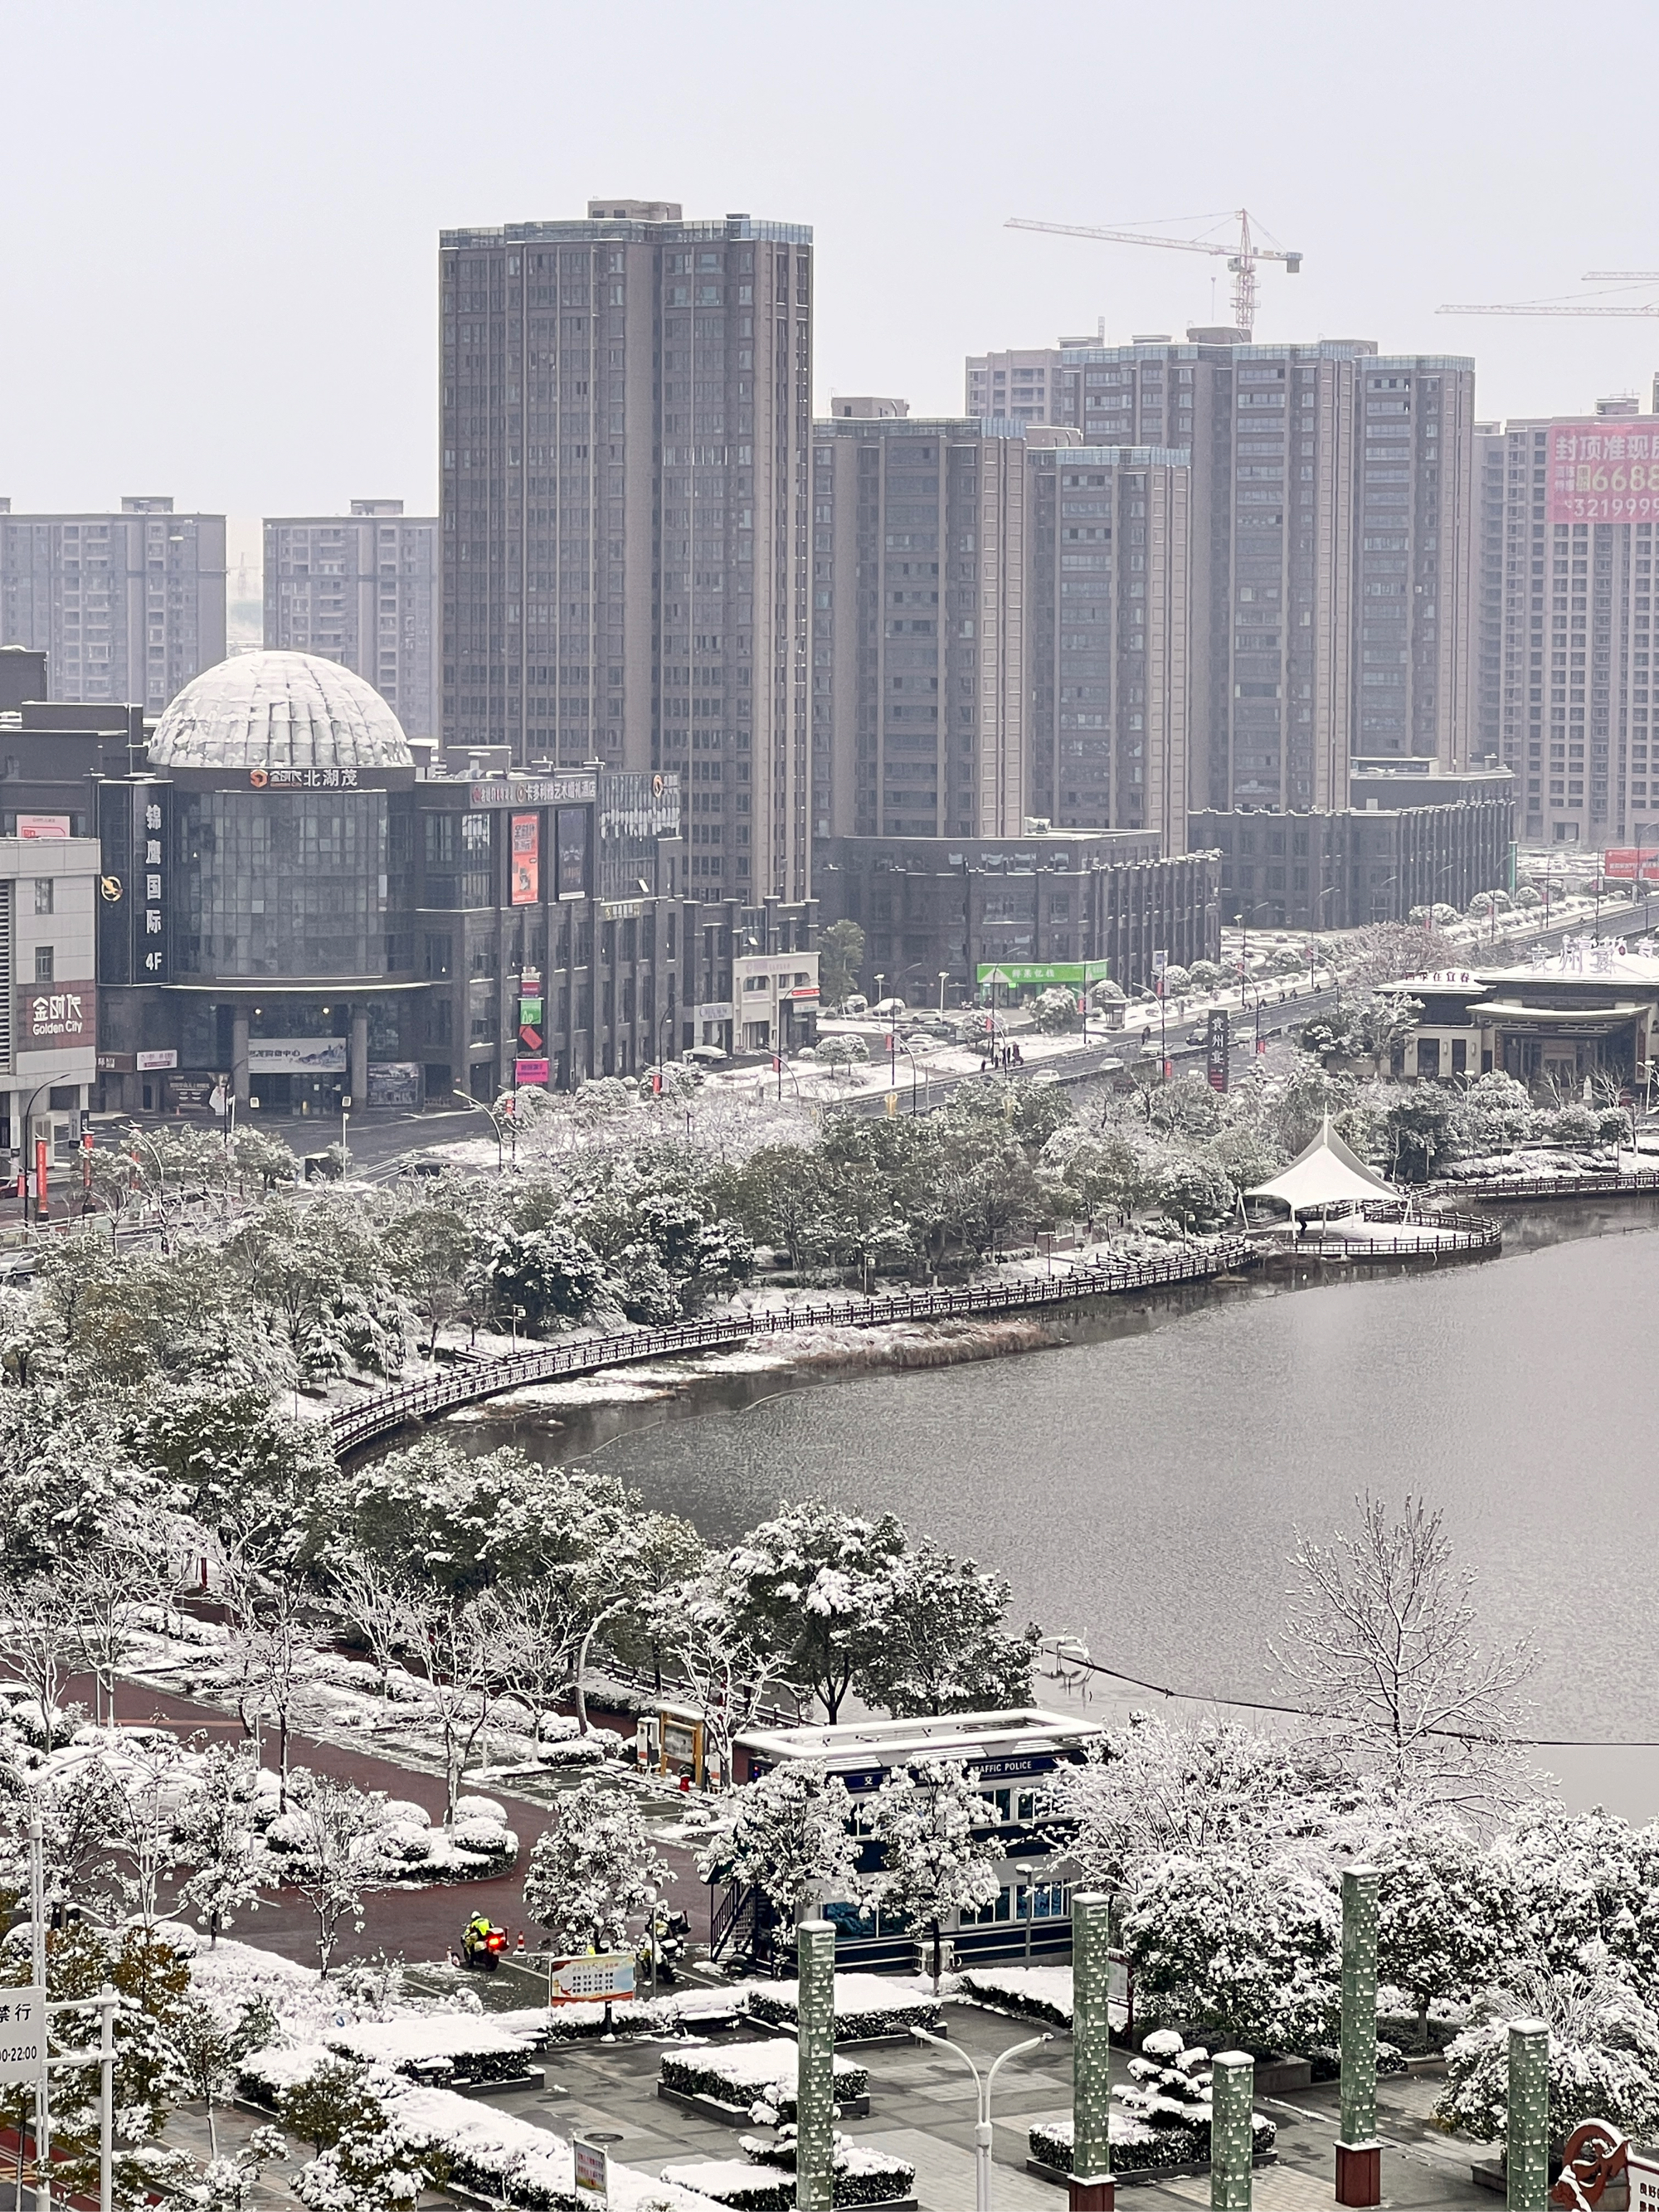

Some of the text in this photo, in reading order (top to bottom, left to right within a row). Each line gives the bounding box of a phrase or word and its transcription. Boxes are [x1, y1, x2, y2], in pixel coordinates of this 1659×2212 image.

[304, 768, 358, 787] 北湖茂
[145, 805, 162, 970] 锦鹰国际 4F
[33, 1020, 82, 1035] Golden City
[1211, 1017, 1224, 1064] 袁州宴
[1005, 1761, 1032, 1772] POLICE
[0, 2003, 32, 2023] 禁行
[0, 2045, 37, 2063] 0-22:00
[1640, 2182, 1659, 2200] 良好
